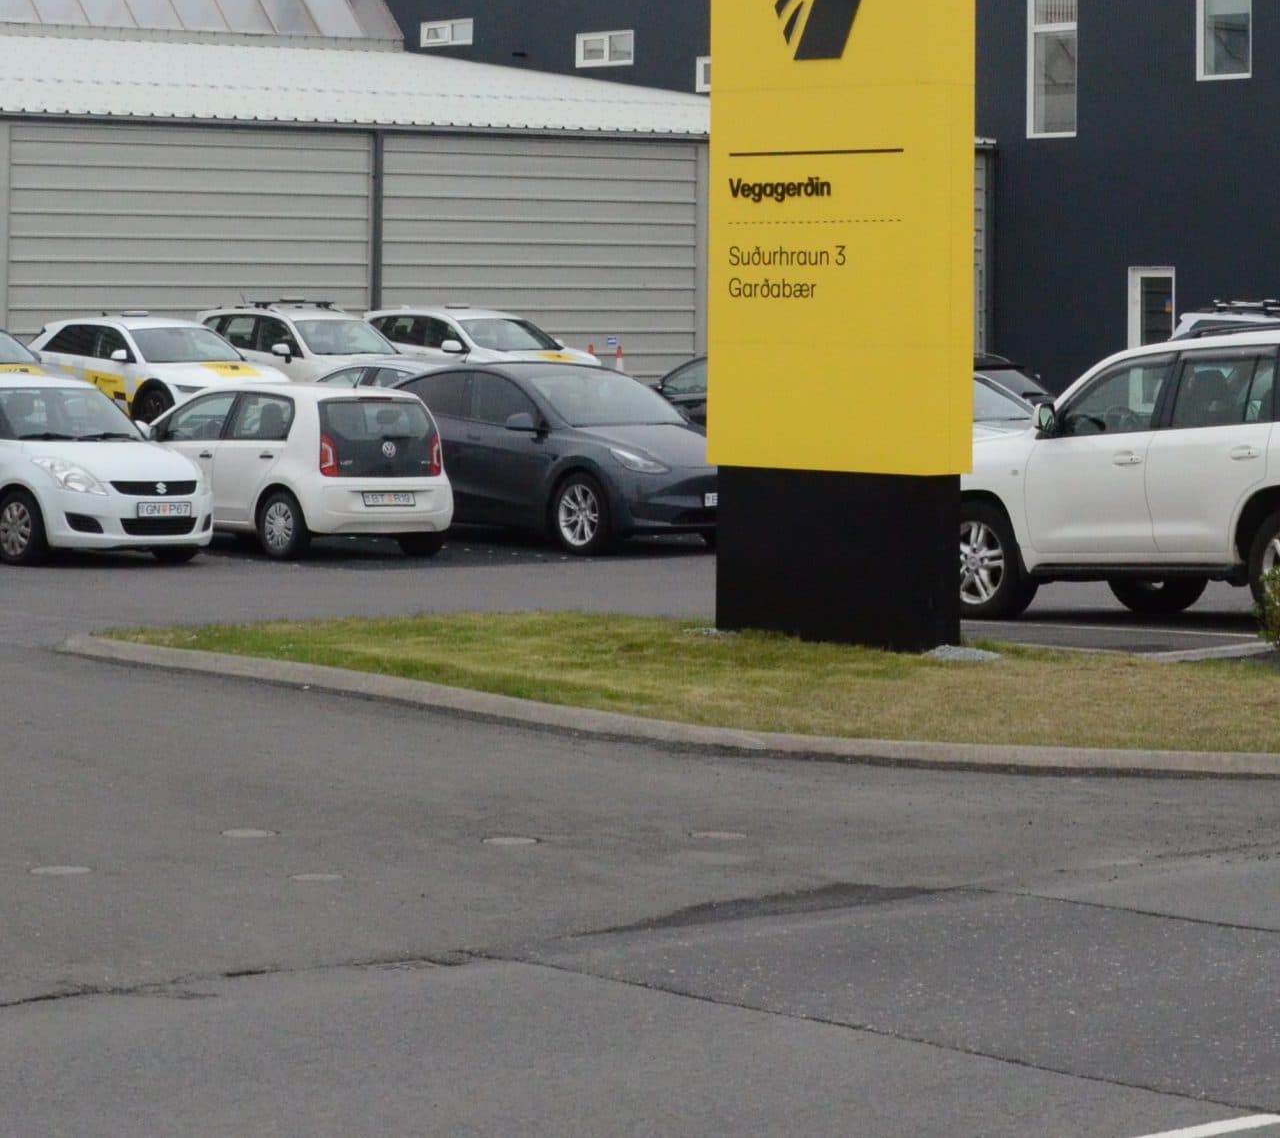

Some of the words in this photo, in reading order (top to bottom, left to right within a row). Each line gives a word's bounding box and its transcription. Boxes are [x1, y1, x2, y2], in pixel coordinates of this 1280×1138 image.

[728, 176, 832, 203] Vegagerðin
[728, 245, 830, 266] Suðurhraun
[834, 245, 847, 266] 3
[728, 277, 817, 299] Garðabær
